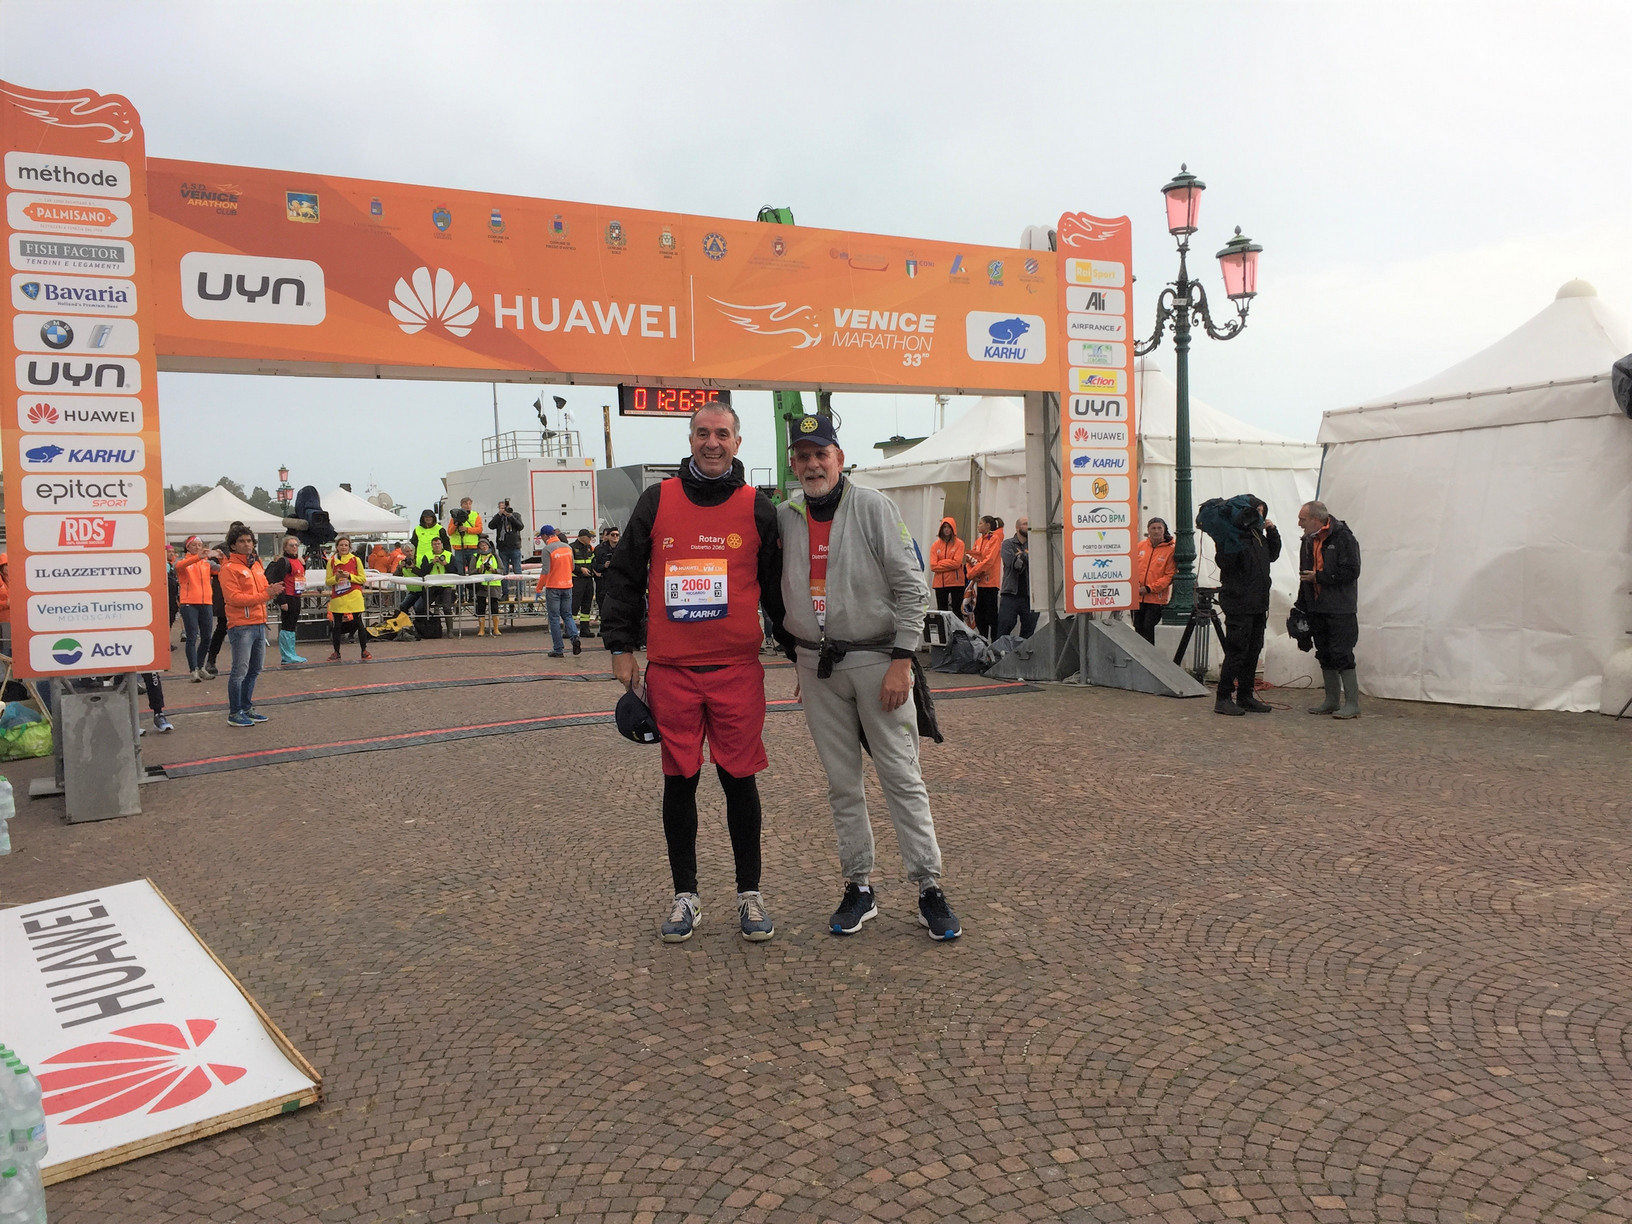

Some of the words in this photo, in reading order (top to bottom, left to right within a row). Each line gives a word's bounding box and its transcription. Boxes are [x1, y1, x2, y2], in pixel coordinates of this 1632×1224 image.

[19, 164, 118, 187] méthode
[180, 190, 239, 202] VENICE
[36, 207, 105, 223] PALMISANO
[26, 243, 58, 255] FISH
[64, 246, 119, 259] FACTOR
[73, 262, 120, 270] LEGAMENTI
[1077, 268, 1091, 277] Rai
[1093, 269, 1115, 279] Sport
[44, 284, 128, 303] Bavaria
[494, 294, 677, 338] HUAWEI
[833, 308, 936, 333] VENICE
[832, 331, 932, 351] MARATHON
[984, 346, 1026, 360] KARHU
[64, 410, 135, 422] HUAWEI
[1091, 432, 1124, 440] HUAWEI
[68, 449, 135, 463] KARHU
[1092, 458, 1125, 468] KARHU
[37, 479, 128, 504] epitact
[1078, 514, 1107, 523] BANCO
[66, 518, 105, 541] RDS
[699, 535, 726, 544] Rotary
[35, 569, 50, 578] IL
[52, 566, 142, 578] GAZZETTINO
[1083, 571, 1122, 580] ALILAGUNA
[682, 579, 711, 591] 2060
[1092, 597, 1115, 606] UNICA
[37, 603, 89, 615] Venezia
[90, 602, 144, 613] Turismo
[689, 610, 721, 618] KARHU
[58, 613, 123, 622] MOTOSCAFI
[91, 643, 132, 657] Actv
[20, 898, 165, 1029] HUAWEI
